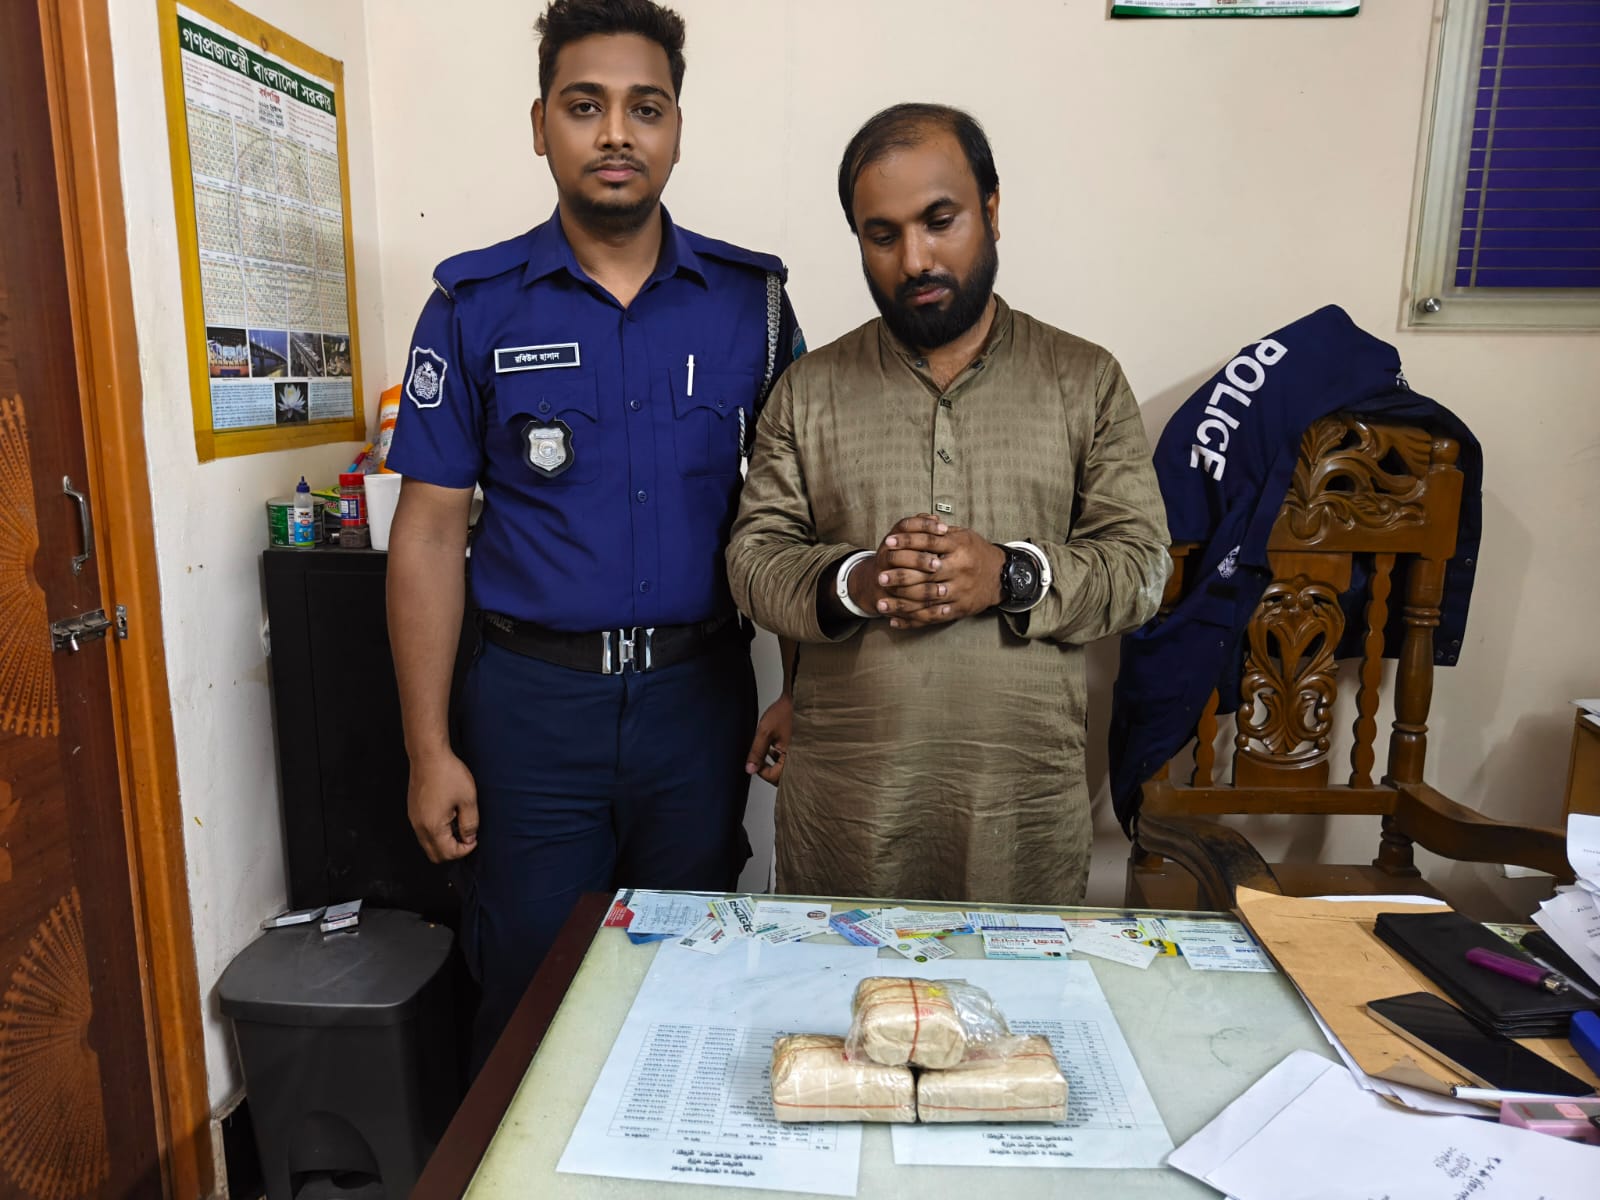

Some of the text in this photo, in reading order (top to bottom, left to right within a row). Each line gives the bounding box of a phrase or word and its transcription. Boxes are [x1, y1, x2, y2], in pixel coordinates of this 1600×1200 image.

[182, 27, 250, 76] গণপ্রজাতন্ত্রী
[252, 59, 299, 97] বাংলাদেশ
[300, 84, 332, 111] সরকার
[1189, 337, 1289, 482] POLICE
